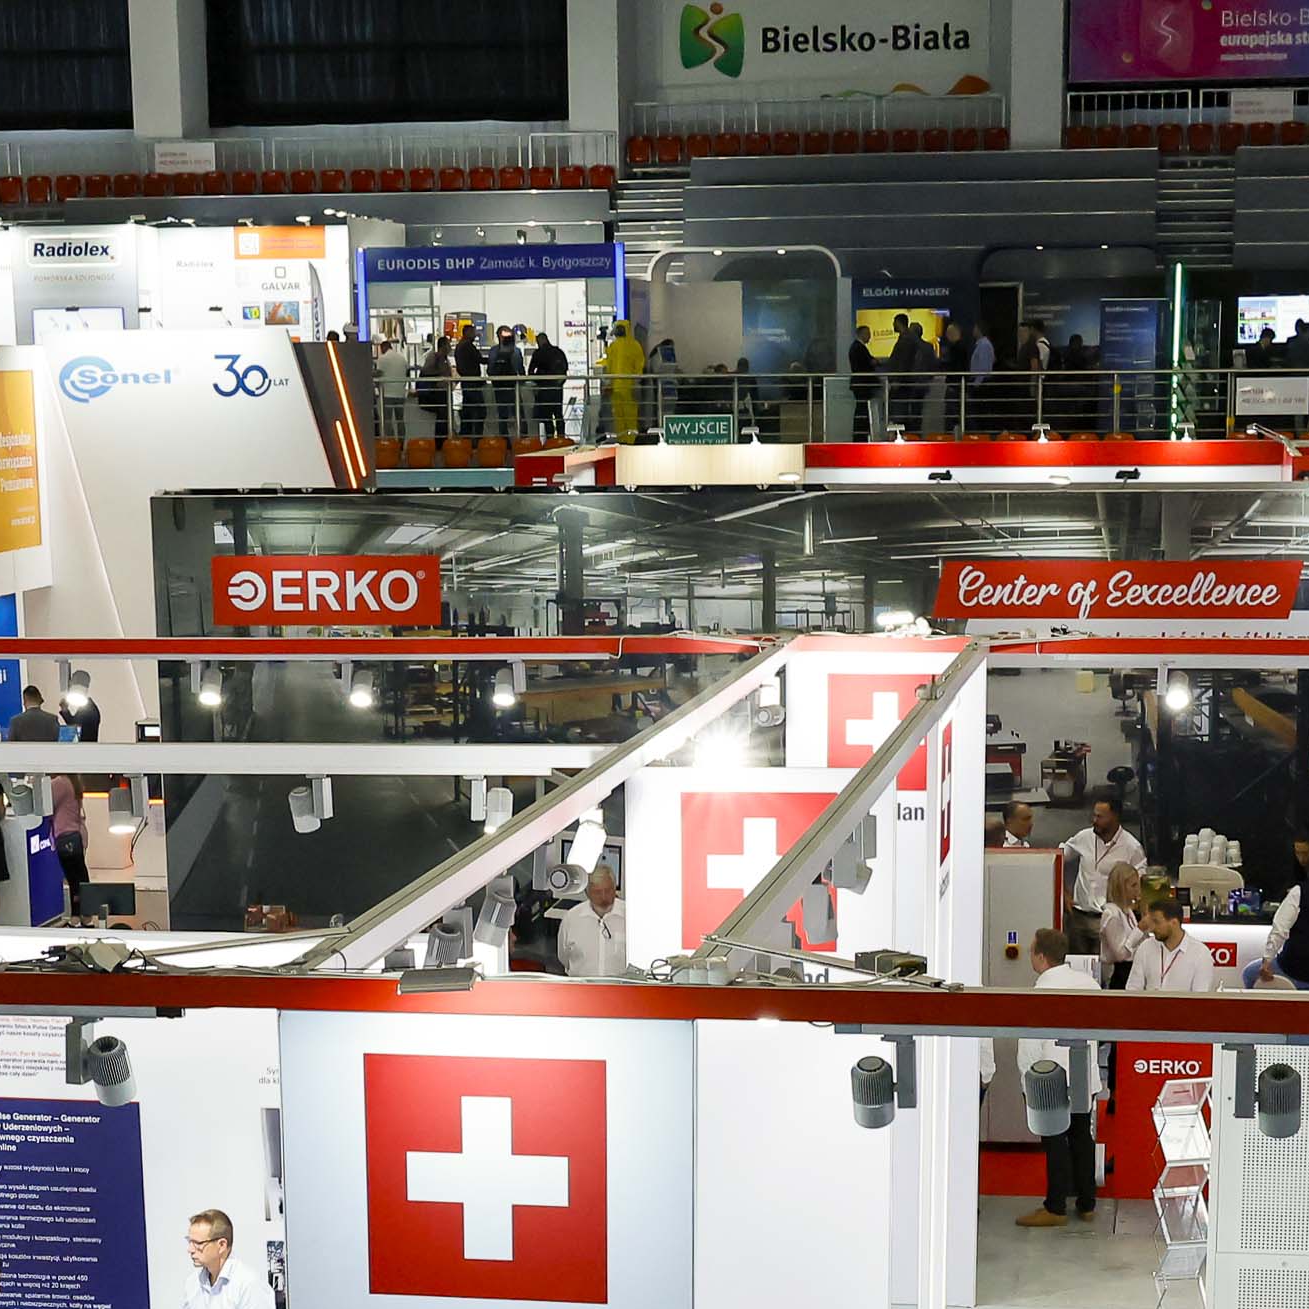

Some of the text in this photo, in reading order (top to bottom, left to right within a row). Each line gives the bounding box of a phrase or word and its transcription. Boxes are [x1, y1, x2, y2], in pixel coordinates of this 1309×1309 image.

[760, 23, 971, 54] Bielsko-Biała
[1220, 31, 1291, 48] europejska
[33, 241, 109, 258] Radiolex
[377, 256, 440, 271] EURODIS
[445, 254, 475, 270] BHP
[542, 252, 612, 270] Bydgoszczy
[261, 282, 301, 291] GALVAR
[78, 369, 171, 385] Sonel
[212, 354, 289, 397] 30 LAT
[669, 420, 729, 434] WYJŚCIE
[272, 570, 419, 612] ERKO
[958, 565, 1060, 607] Center
[1067, 580, 1099, 620] of
[1149, 1059, 1200, 1075] ERKO
[12, 1112, 52, 1122] Generator
[61, 1114, 100, 1123] Generator
[2, 1122, 63, 1134] Uderzeniowych
[27, 1135, 74, 1144] czyszczenia
